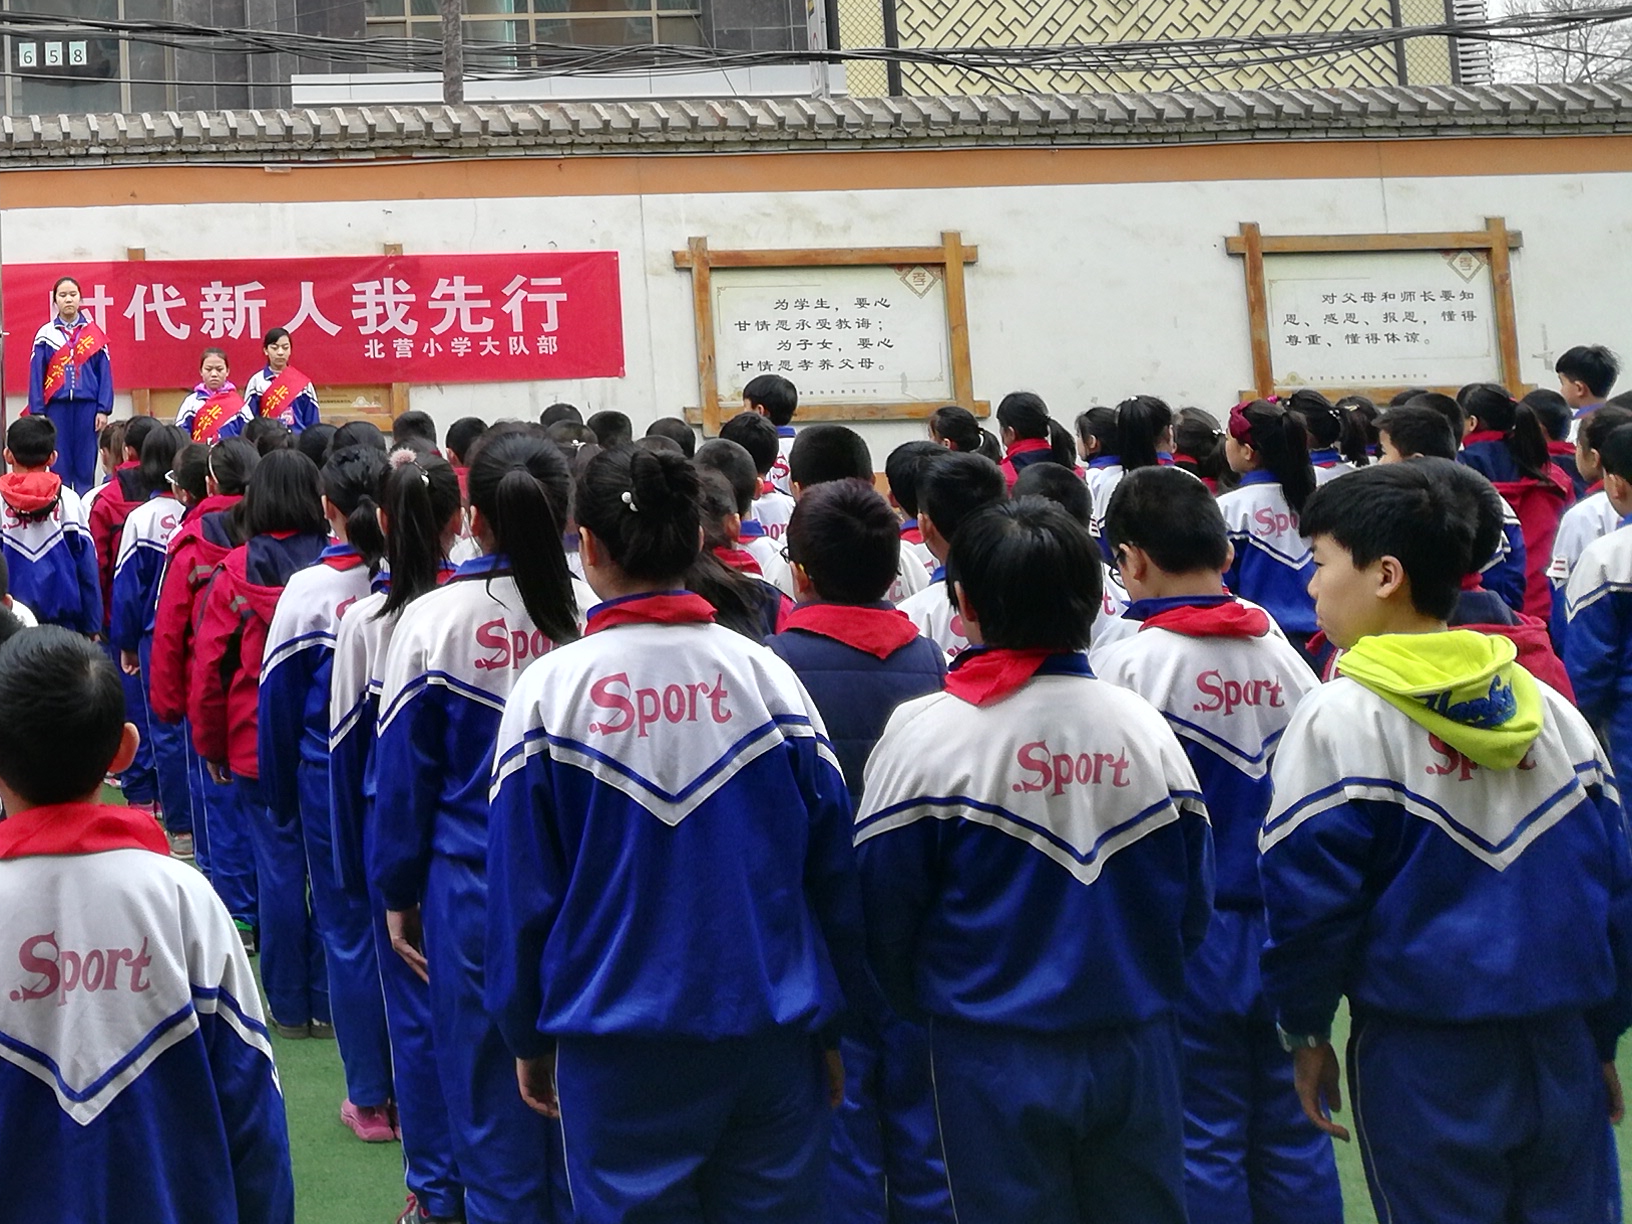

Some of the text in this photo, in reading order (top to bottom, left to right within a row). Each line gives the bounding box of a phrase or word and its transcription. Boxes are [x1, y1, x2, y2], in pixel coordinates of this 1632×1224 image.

[1321, 289, 1475, 305] 对父母和师长要知
[363, 334, 559, 359] 北营小学大队部
[588, 671, 733, 738] Sport
[1193, 669, 1285, 717] Sport
[1012, 739, 1131, 797] Sport
[9, 930, 153, 1008] Sport
